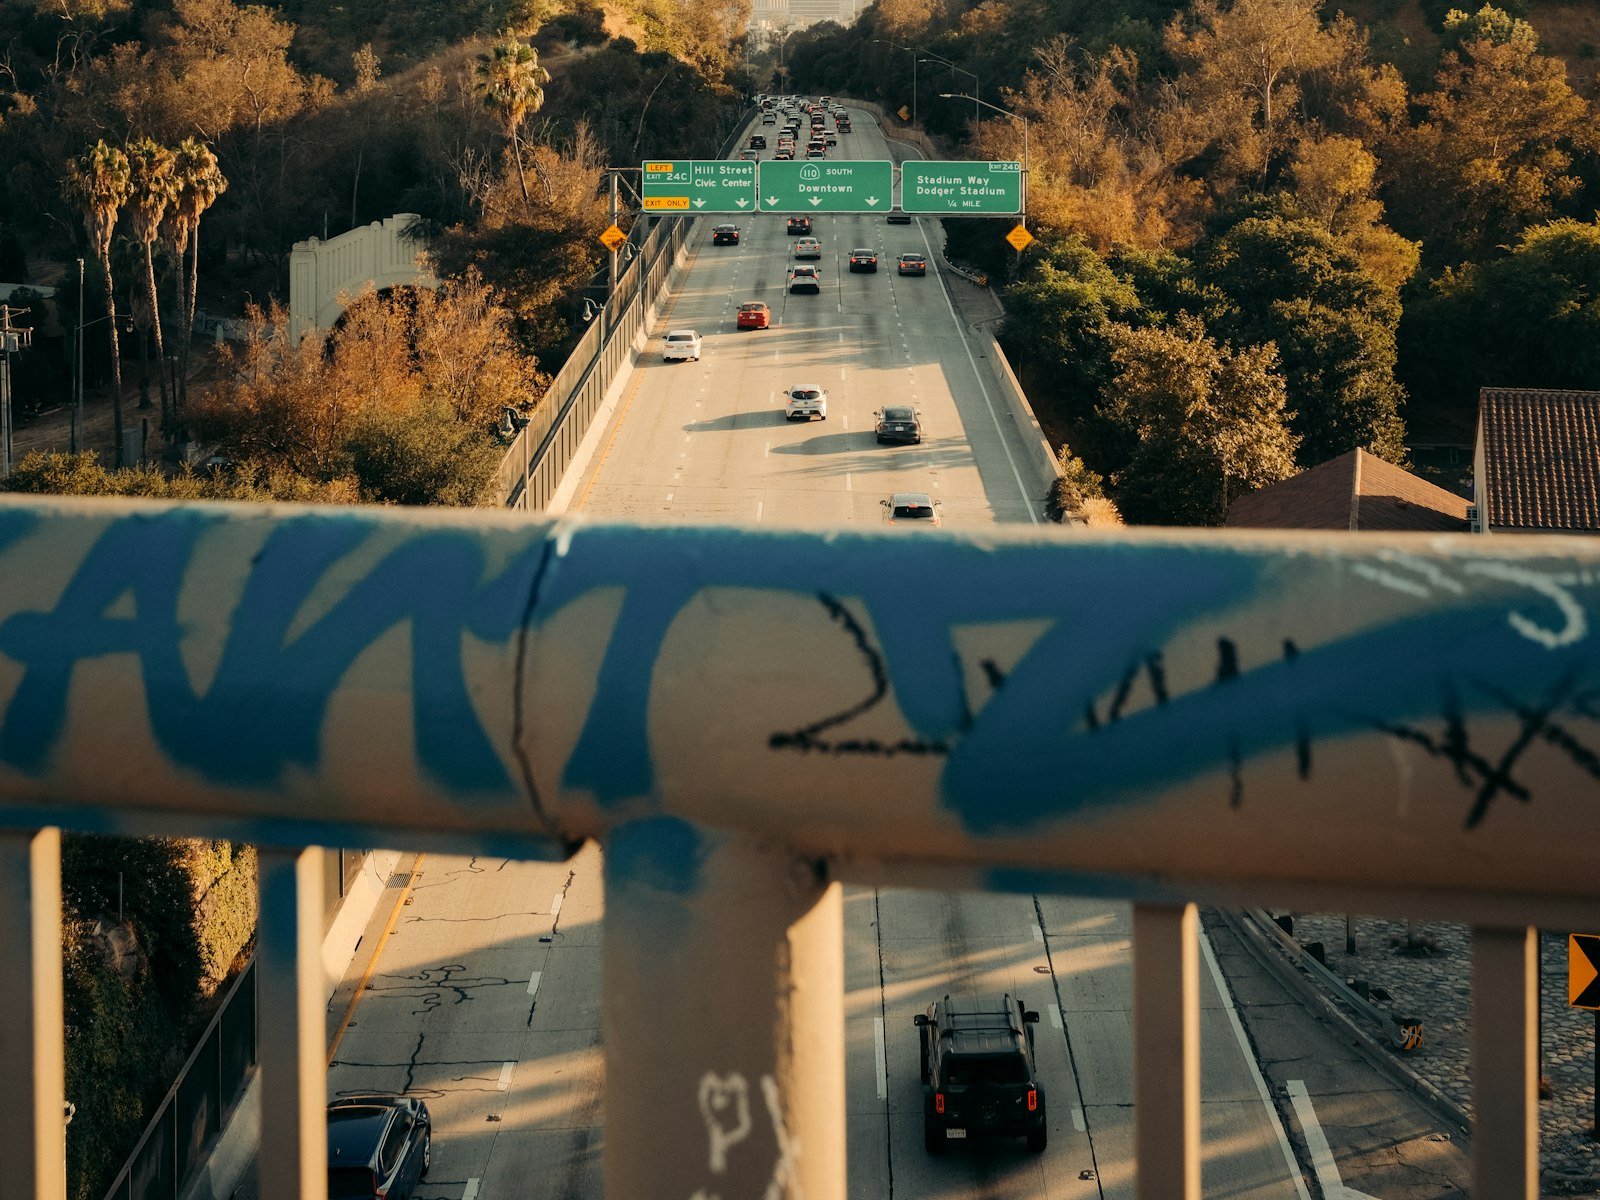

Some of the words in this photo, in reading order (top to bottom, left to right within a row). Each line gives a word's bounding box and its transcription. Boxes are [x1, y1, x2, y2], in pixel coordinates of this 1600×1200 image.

[695, 166, 714, 174] Hill
[720, 166, 752, 174] Street
[803, 169, 817, 177] 110
[695, 179, 716, 187] Civic
[722, 179, 752, 187] Center
[917, 176, 962, 184] Stadium
[968, 176, 989, 186] Way
[799, 184, 852, 192] Downtown
[917, 186, 954, 196] Dodger
[960, 186, 1005, 195] Stadium
